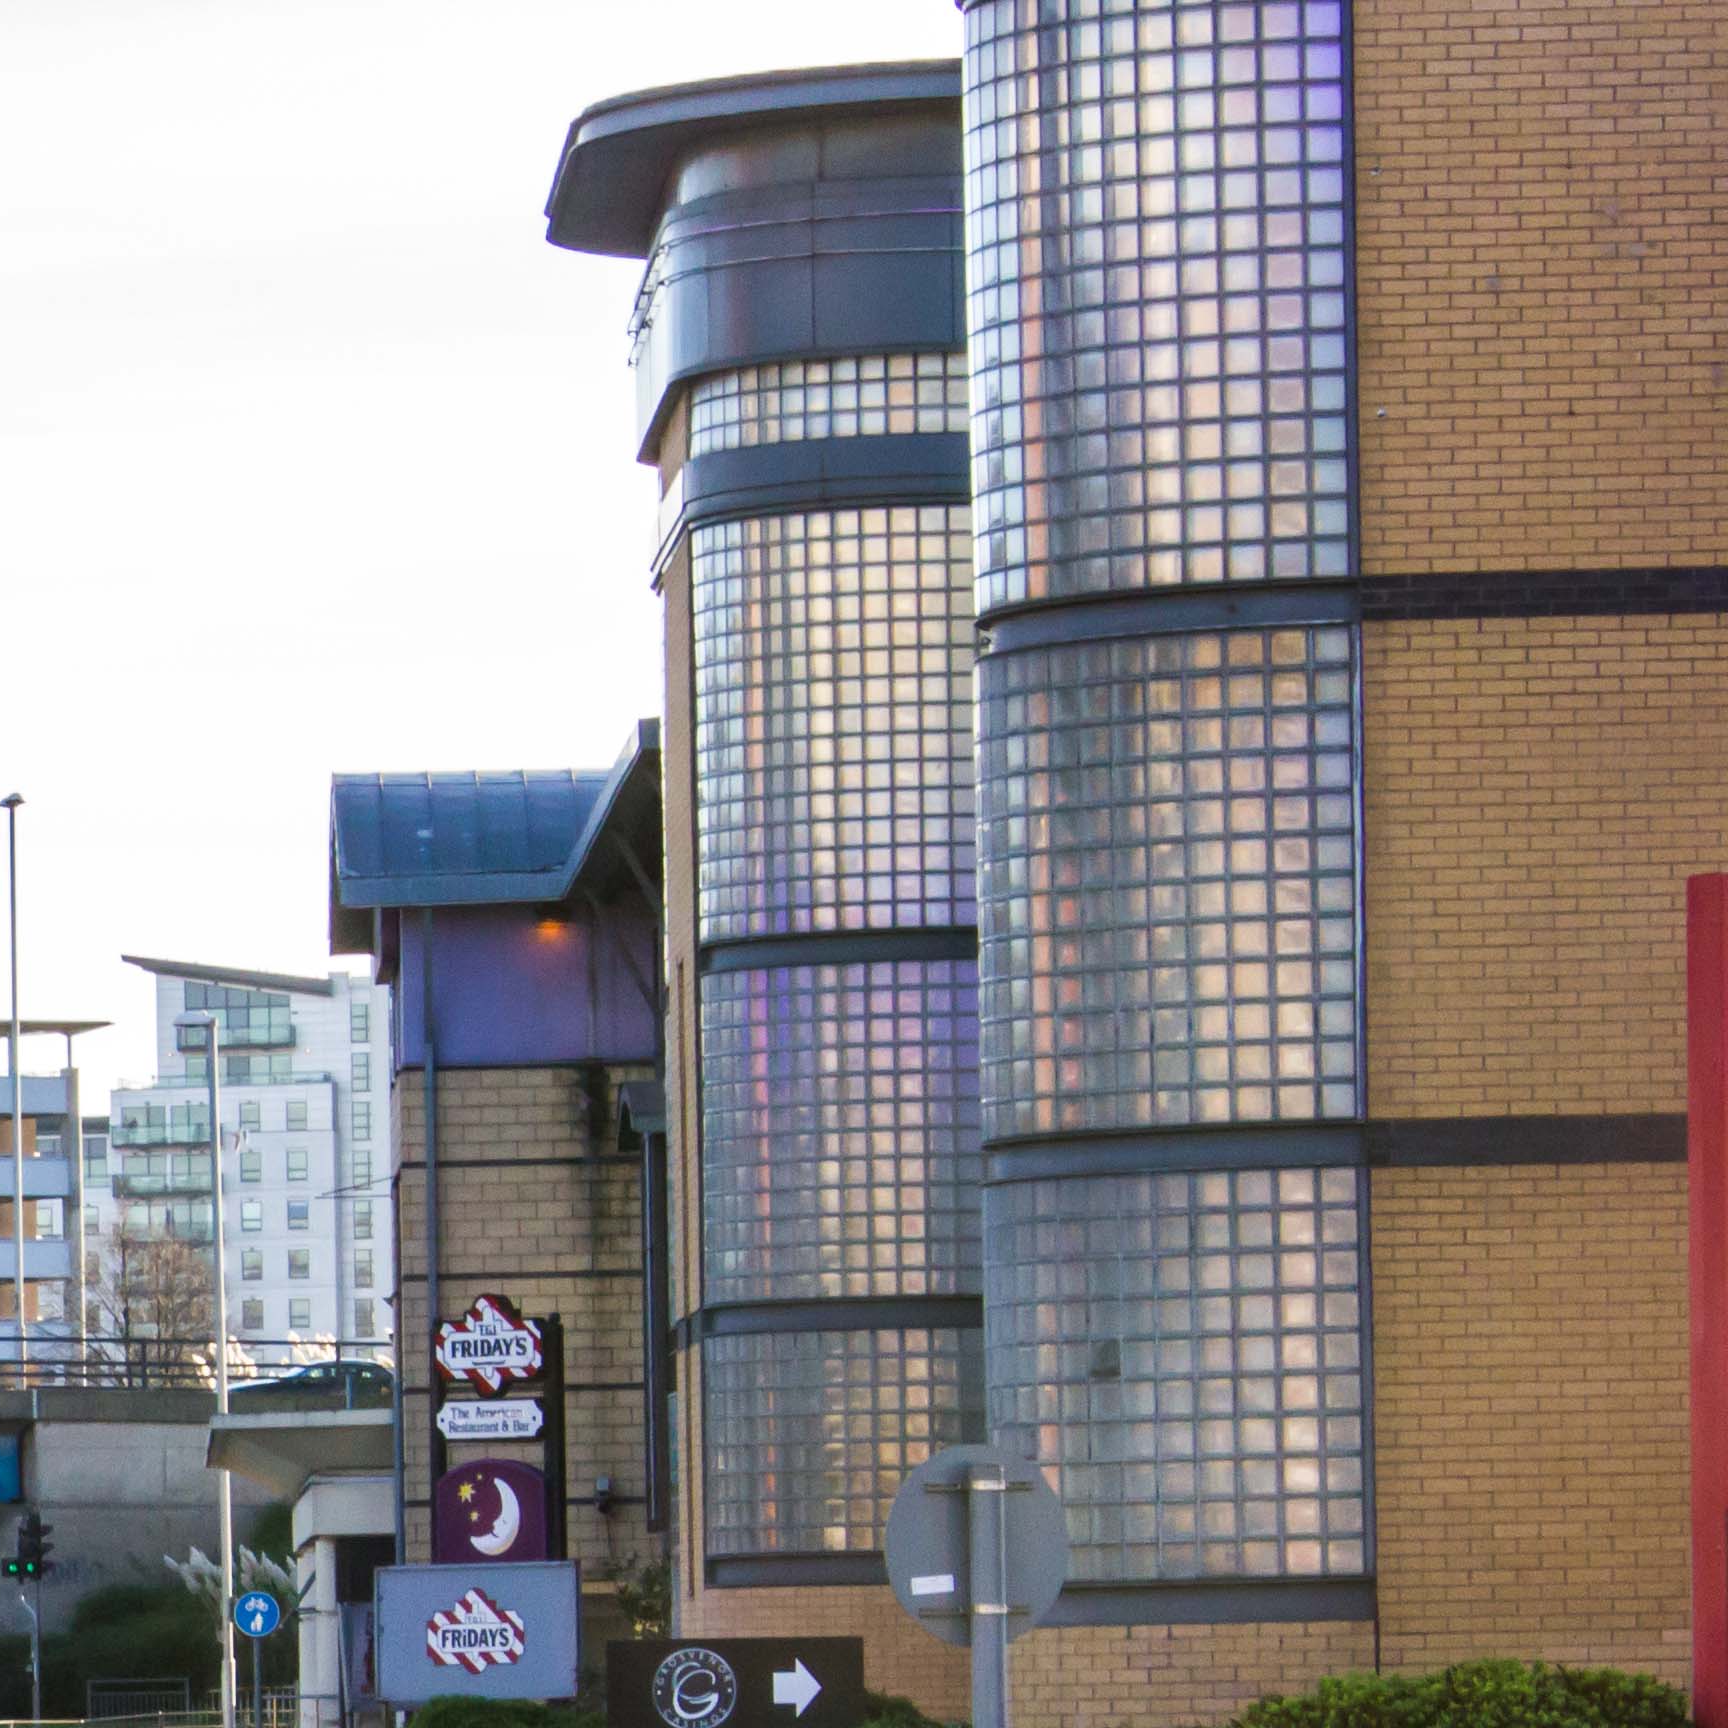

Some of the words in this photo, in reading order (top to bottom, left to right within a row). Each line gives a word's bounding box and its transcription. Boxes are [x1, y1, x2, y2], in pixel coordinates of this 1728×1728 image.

[451, 1335, 528, 1358] FRIDAY'S
[450, 1407, 470, 1420] The
[475, 1406, 524, 1419] American
[448, 1420, 499, 1433] Restaurant
[501, 1420, 510, 1433] &
[513, 1419, 529, 1432] Bar
